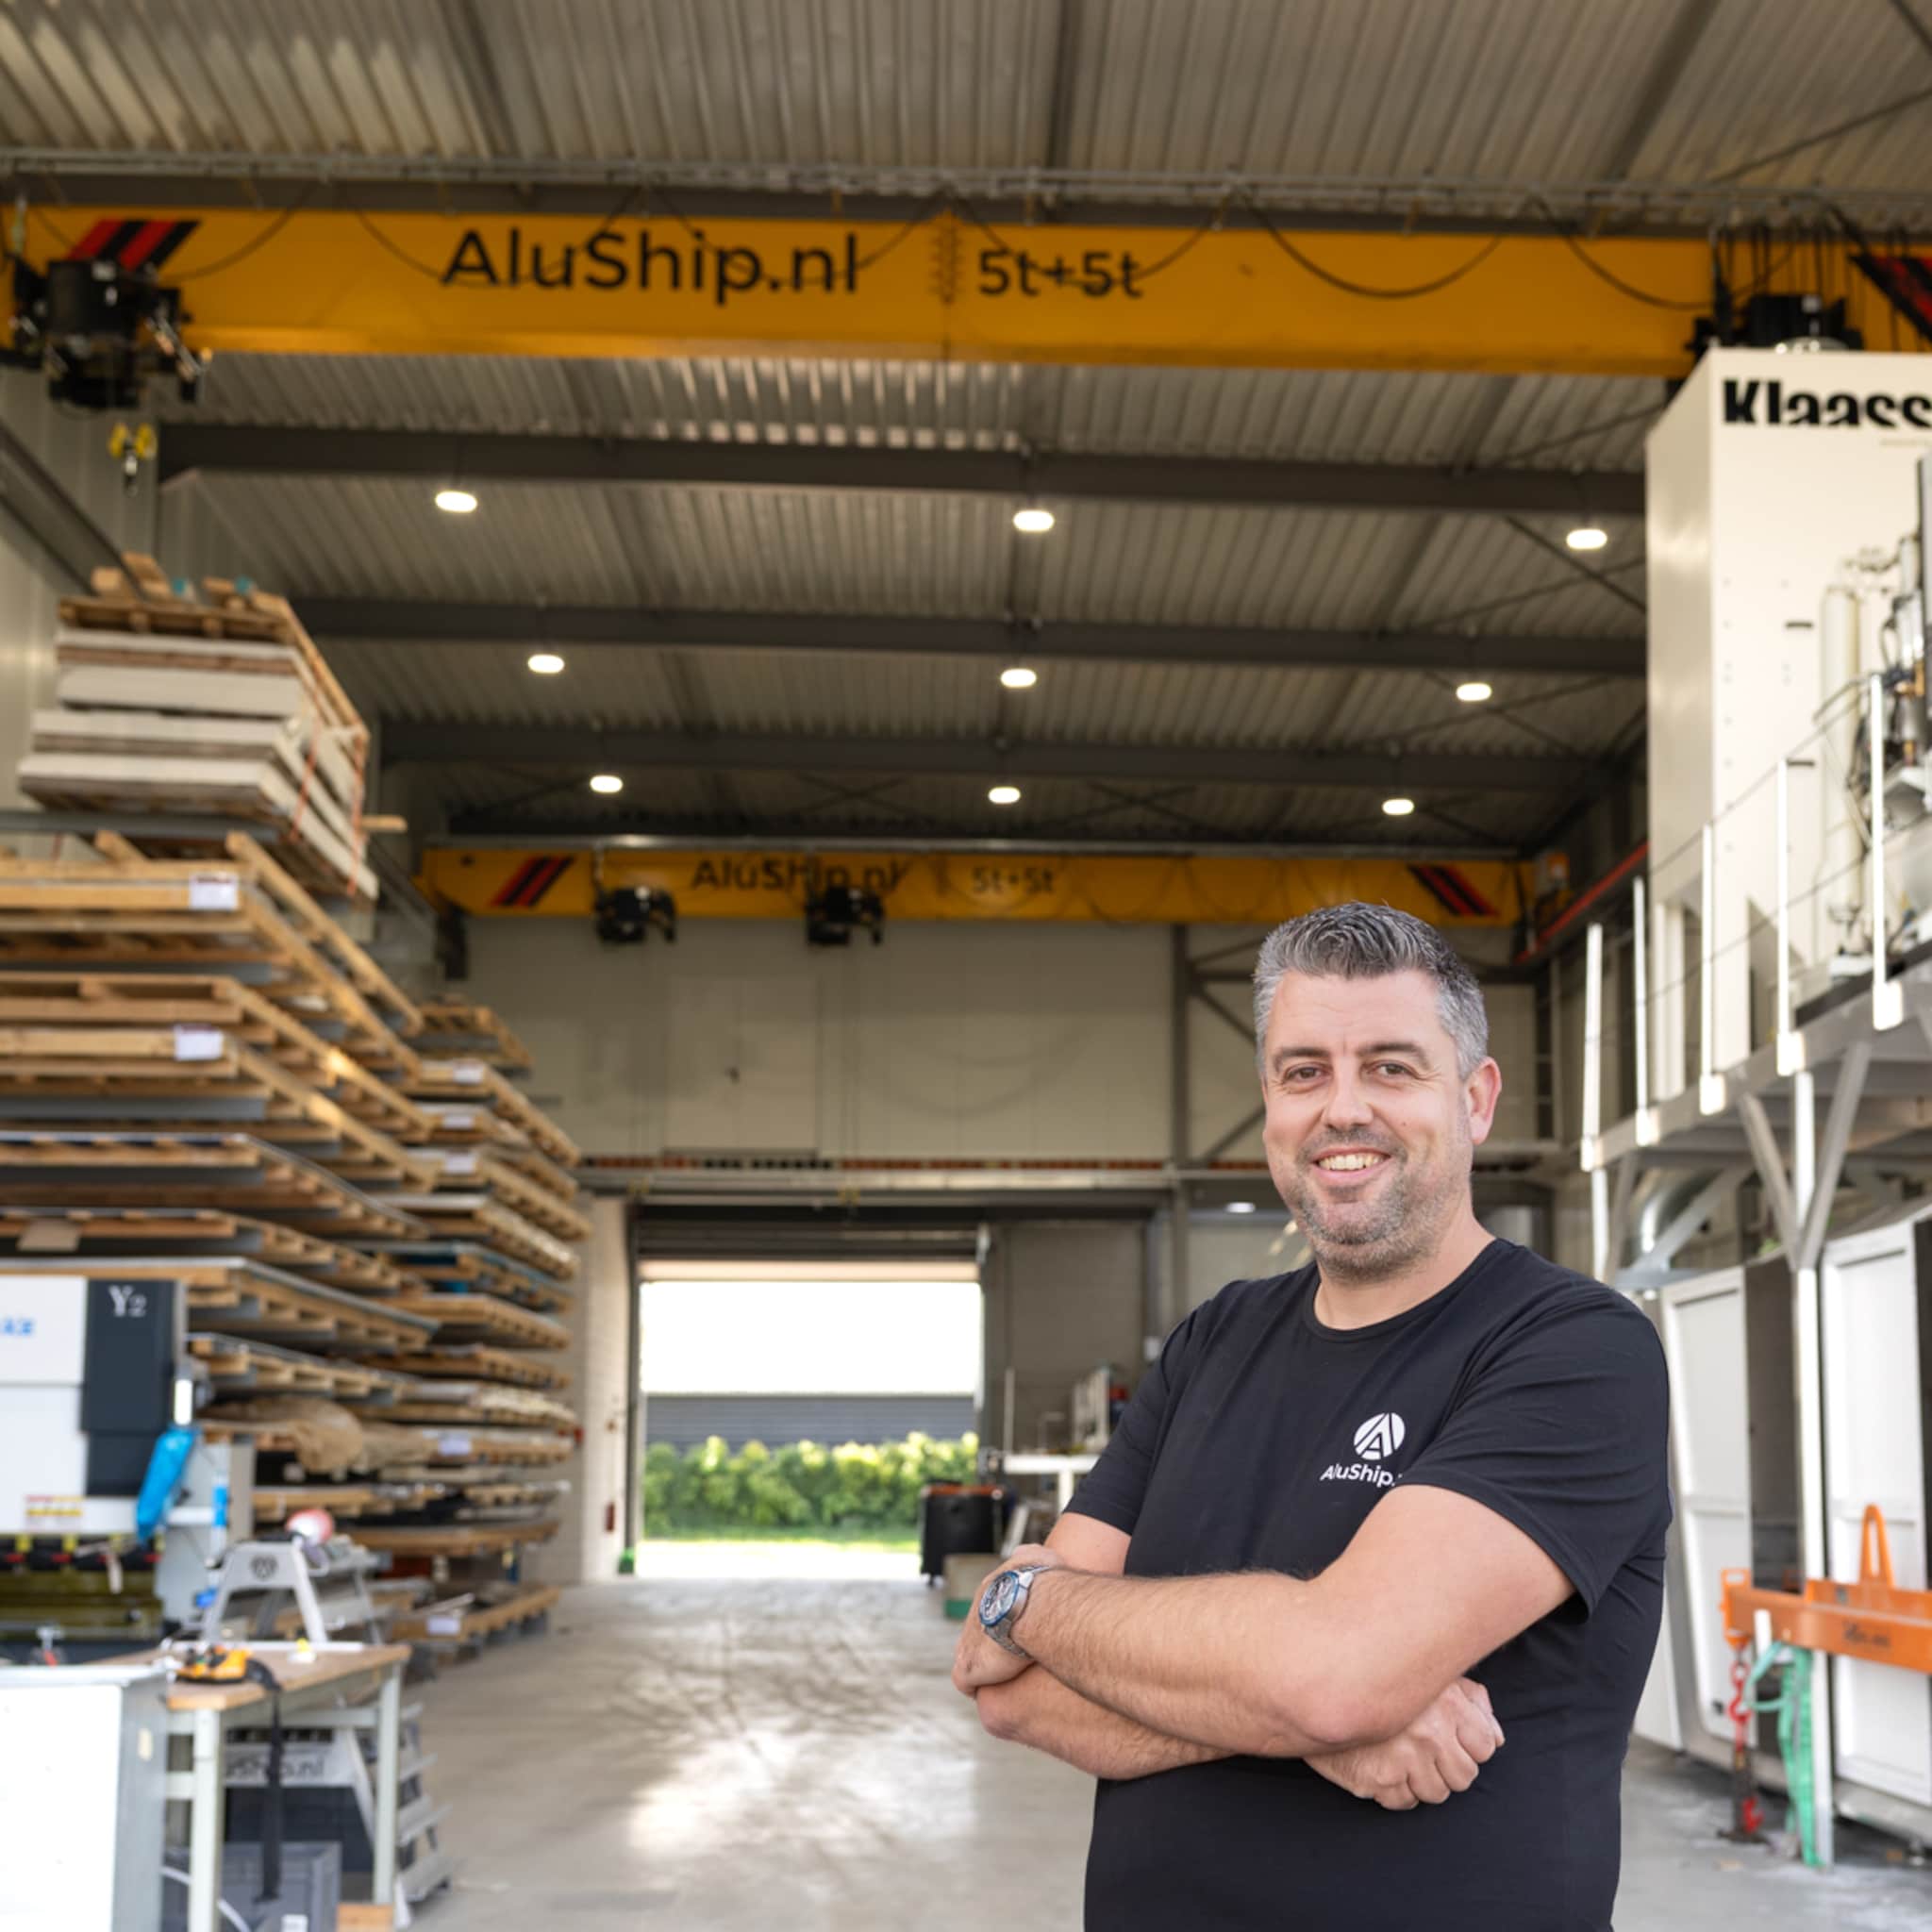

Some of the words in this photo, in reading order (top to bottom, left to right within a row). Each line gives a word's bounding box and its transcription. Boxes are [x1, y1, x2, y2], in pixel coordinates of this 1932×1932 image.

[442, 227, 857, 307] AluShip.nl
[978, 248, 1144, 298] 5t+5t
[1723, 378, 1932, 427] Klaass
[1320, 1463, 1403, 1488] AluShip.
